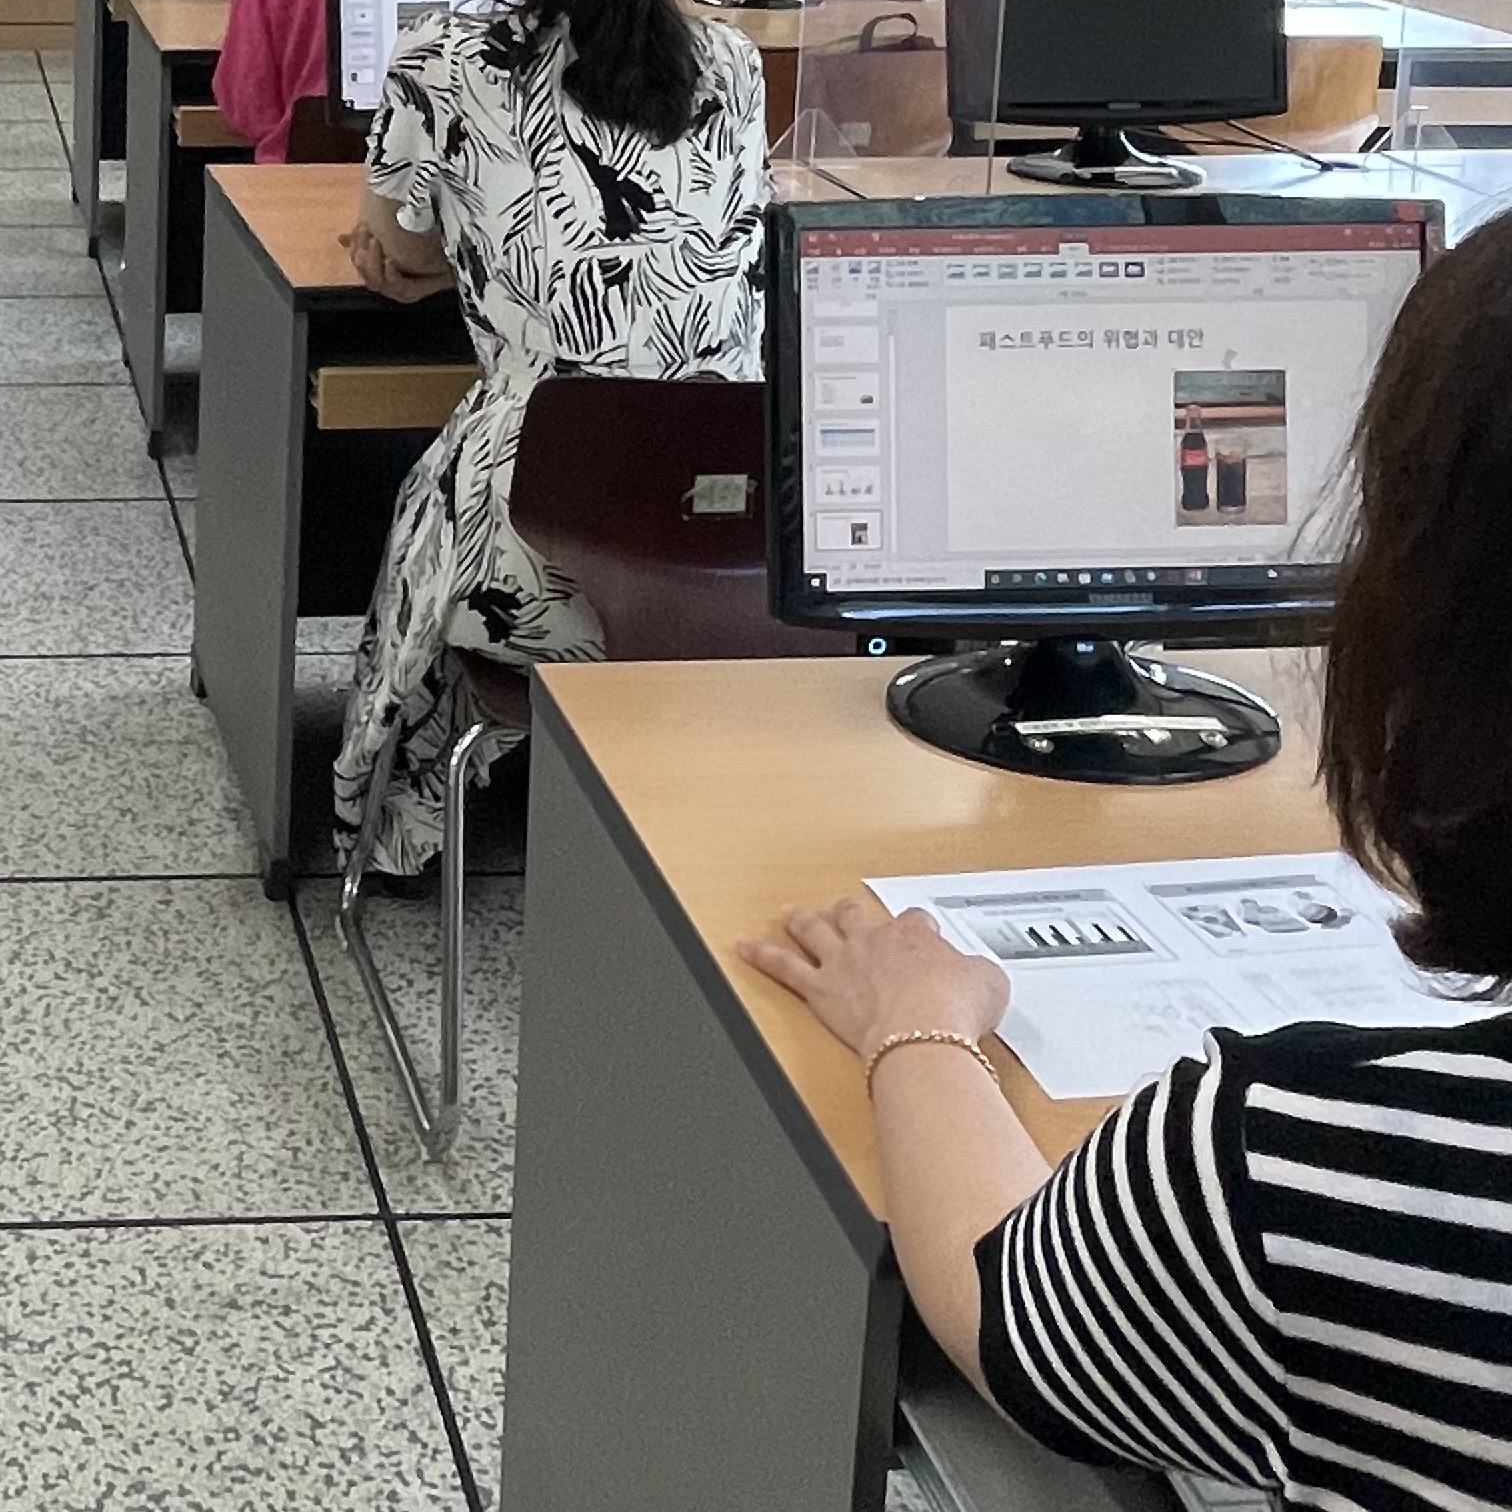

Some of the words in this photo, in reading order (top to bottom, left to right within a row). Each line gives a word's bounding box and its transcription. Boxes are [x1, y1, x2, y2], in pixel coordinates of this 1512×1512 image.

[978, 328, 1094, 351] 패스트푸드의
[1103, 327, 1158, 351] 위험과
[1167, 326, 1205, 350] 대안
